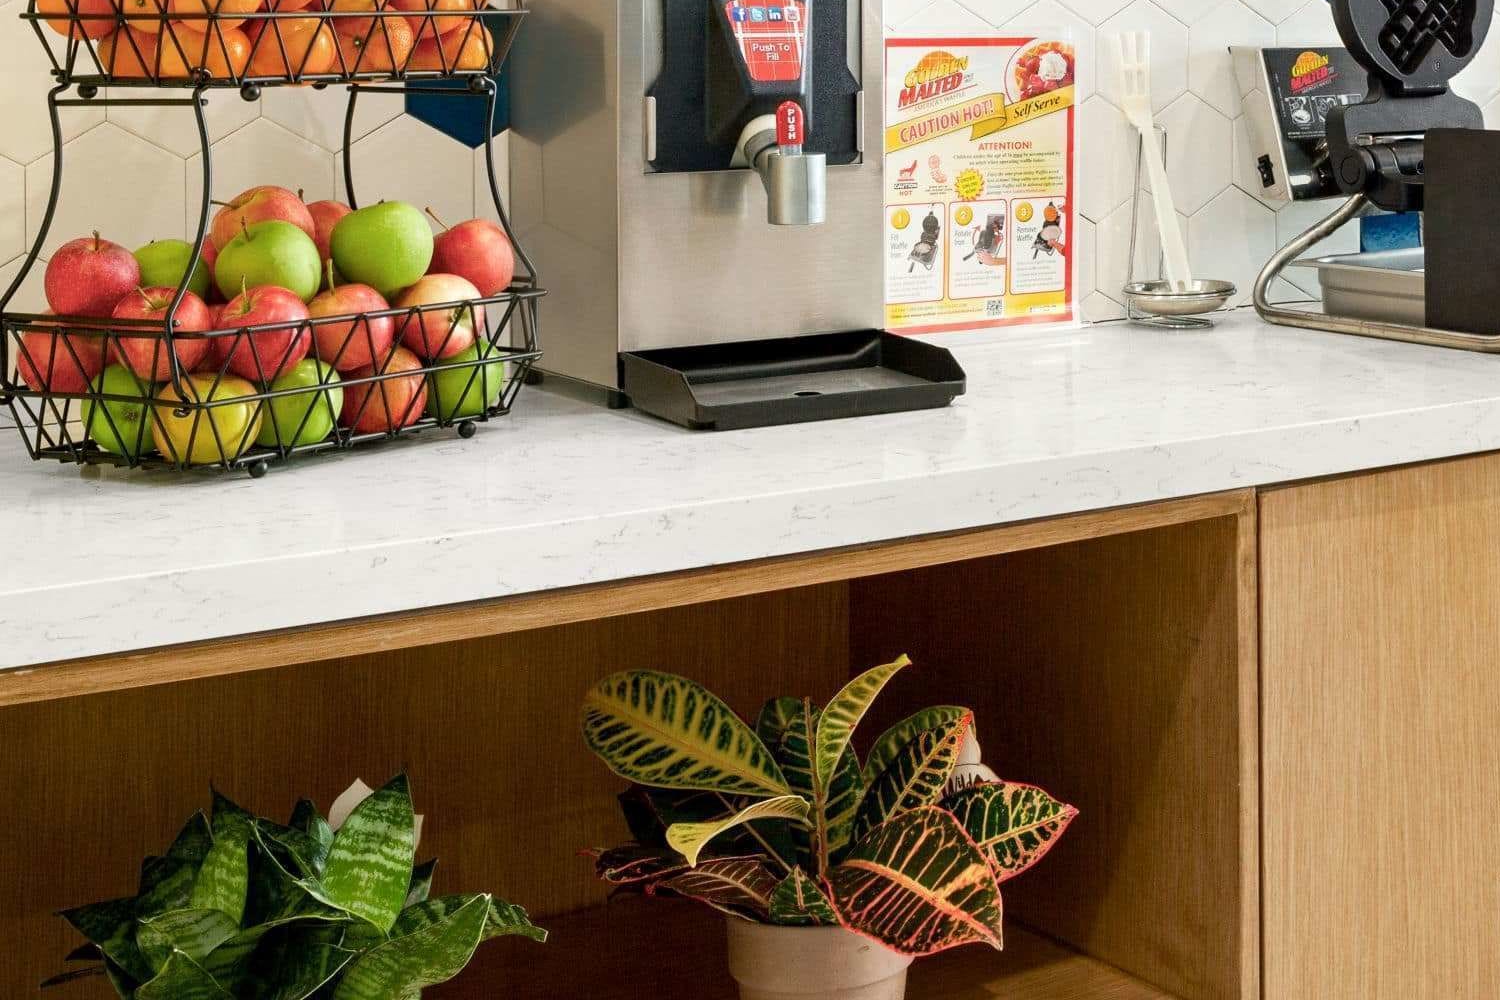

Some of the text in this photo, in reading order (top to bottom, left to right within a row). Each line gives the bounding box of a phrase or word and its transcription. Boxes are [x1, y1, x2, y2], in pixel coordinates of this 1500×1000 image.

[752, 43, 790, 52] Push To
[766, 52, 779, 61] Fill
[898, 72, 963, 108] MALTED
[1013, 95, 1061, 119] Self Serve
[787, 108, 796, 140] PUSH
[900, 99, 994, 143] CAUTION HOT!
[978, 140, 1033, 151] ATTENTION!
